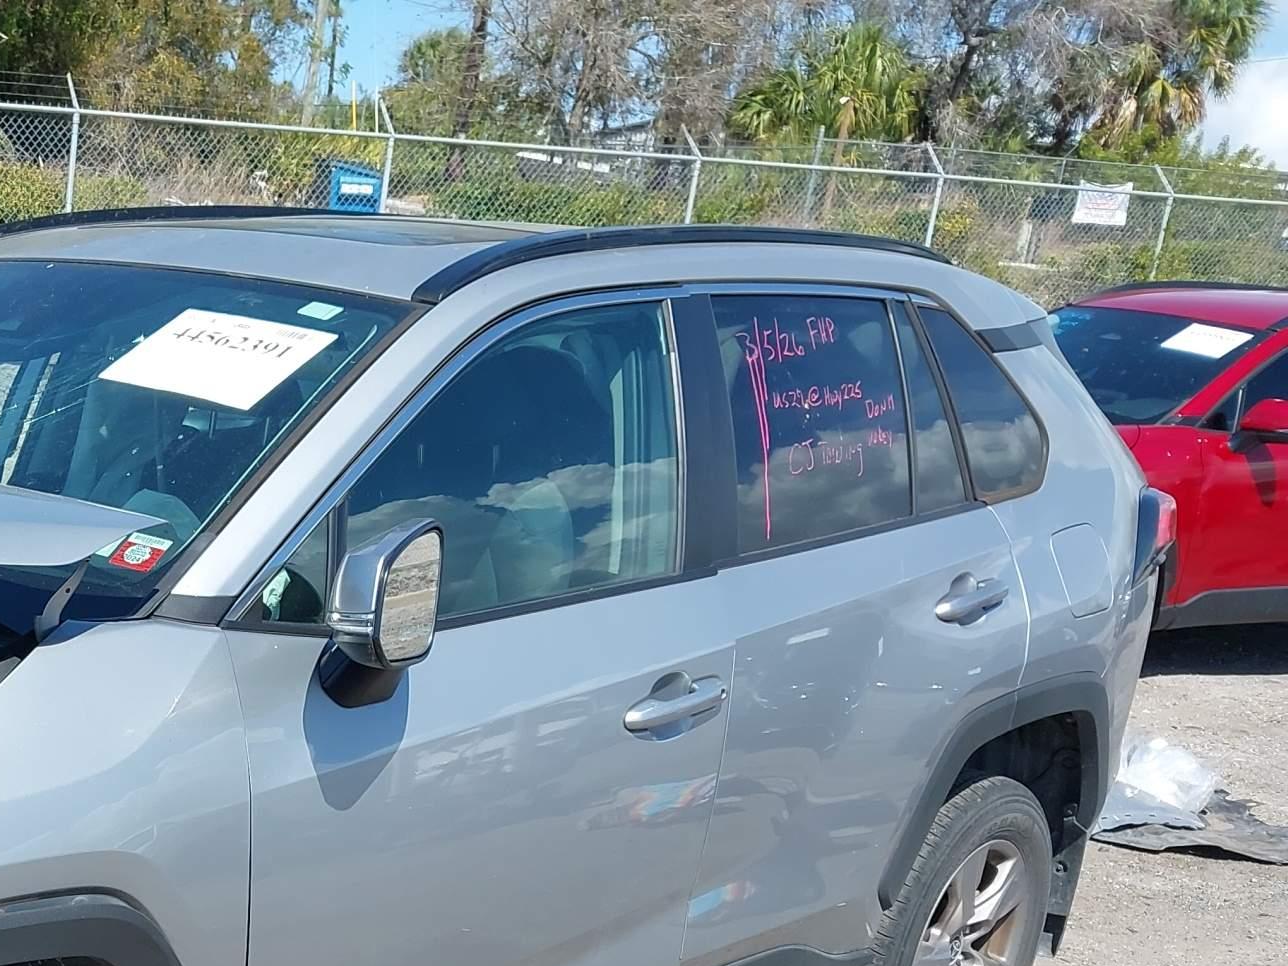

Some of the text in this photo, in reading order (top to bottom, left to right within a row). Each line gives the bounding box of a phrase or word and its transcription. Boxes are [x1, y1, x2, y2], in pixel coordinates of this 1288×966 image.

[172, 327, 294, 359] 44562391
[735, 316, 835, 363] 3/5/26 FHP
